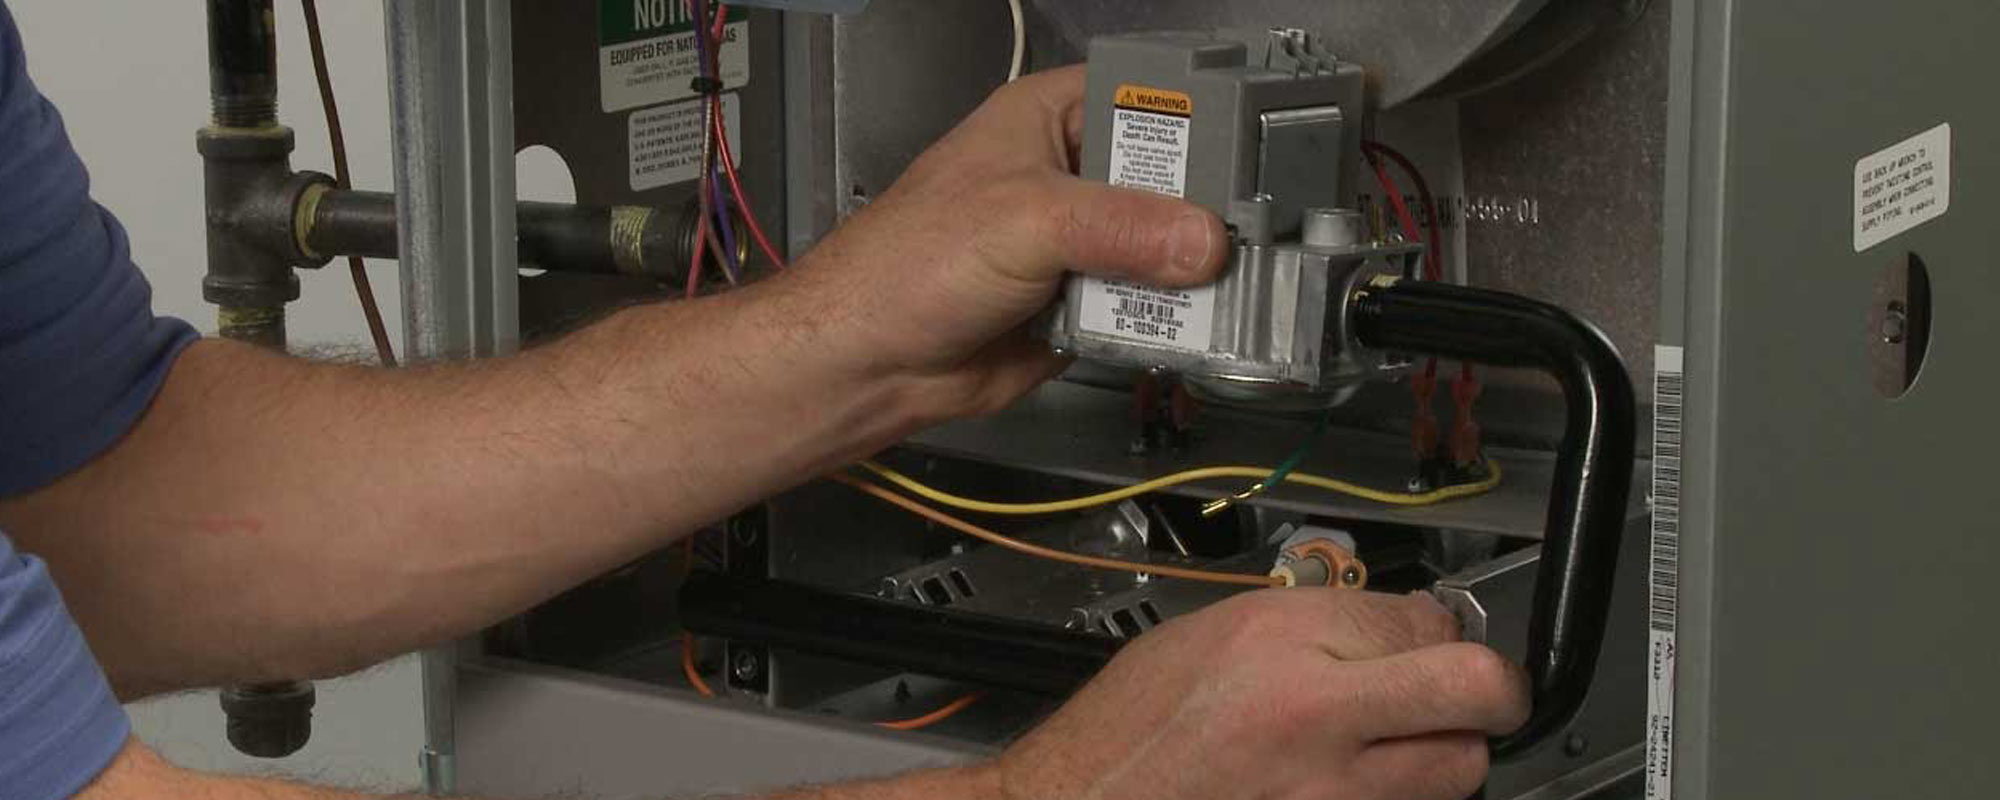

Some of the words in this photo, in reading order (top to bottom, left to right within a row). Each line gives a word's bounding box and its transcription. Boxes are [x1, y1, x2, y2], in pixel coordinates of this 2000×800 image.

[611, 43, 654, 65] EQUIPPED
[656, 39, 674, 57] FOR
[1136, 92, 1187, 110] WARNING
[1119, 112, 1155, 124] EXPLOSION
[1127, 122, 1148, 132] Severe
